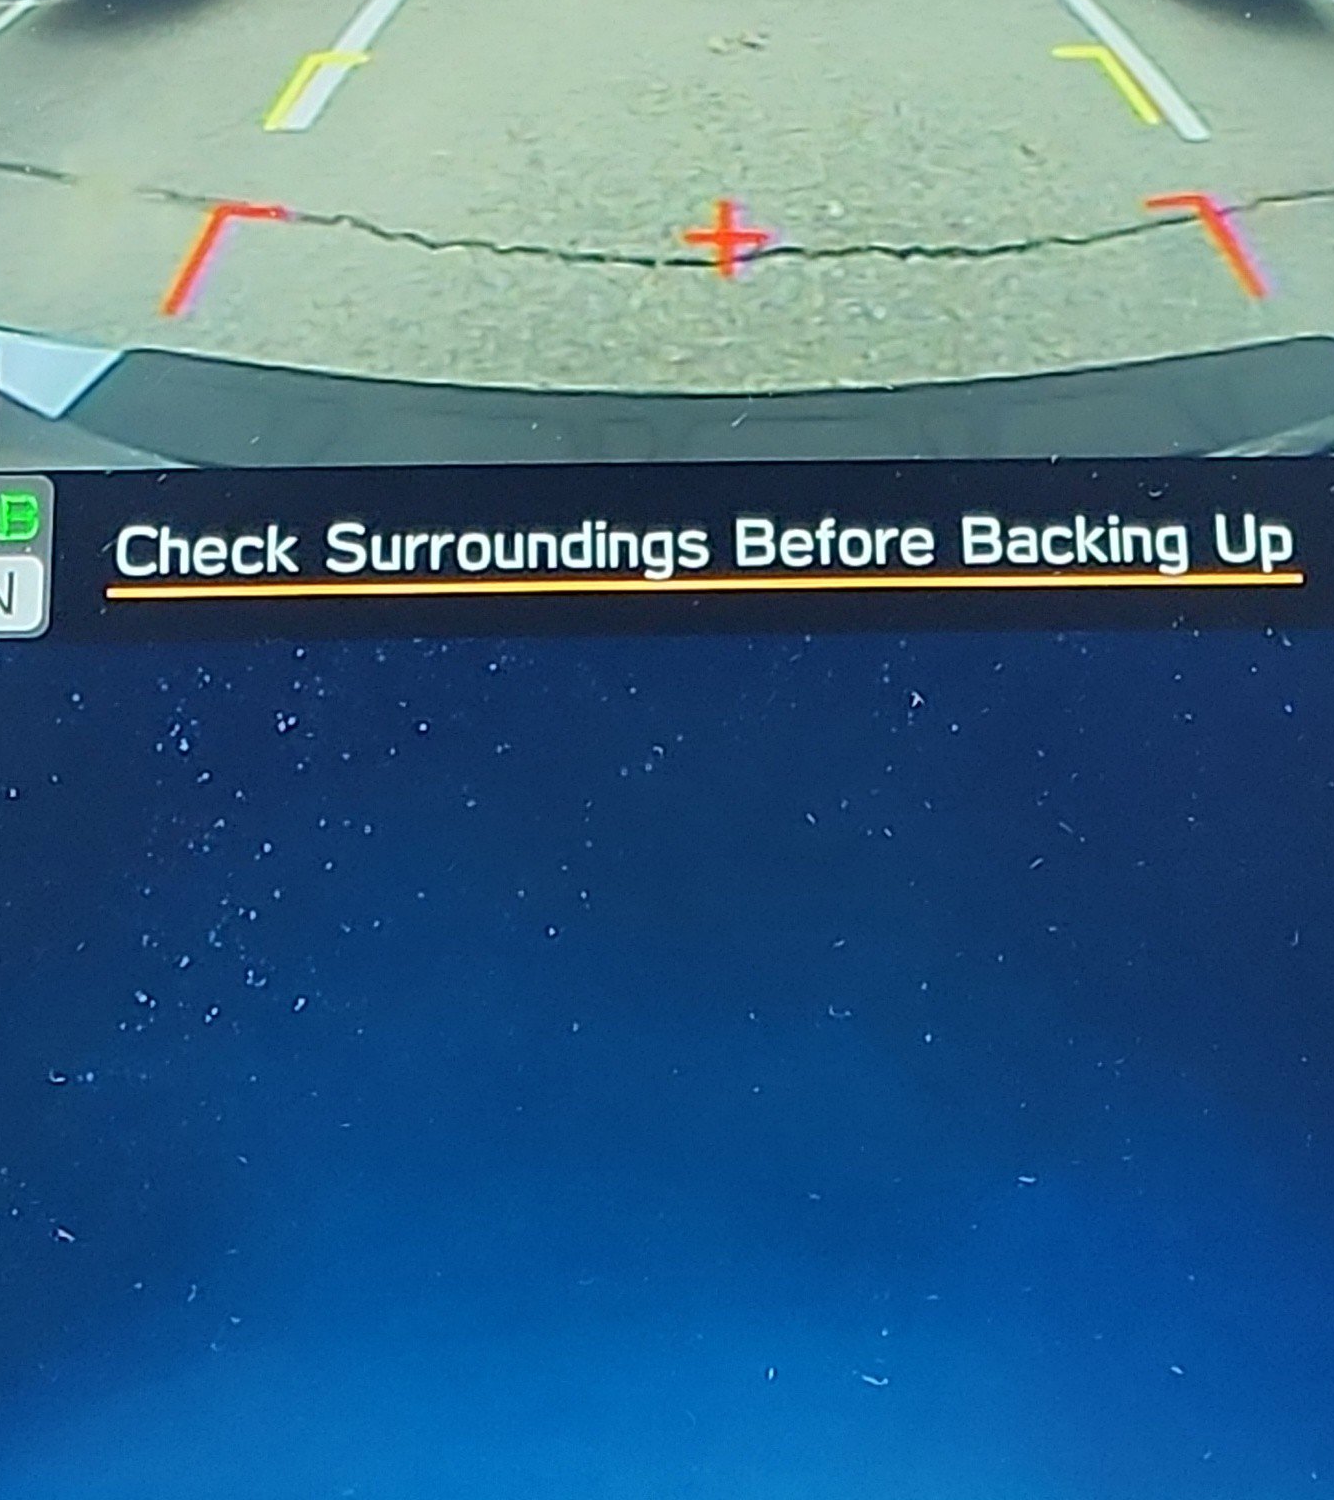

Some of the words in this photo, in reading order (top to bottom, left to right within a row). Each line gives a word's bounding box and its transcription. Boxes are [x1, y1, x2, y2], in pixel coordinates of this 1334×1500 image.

[115, 526, 298, 577] Check
[325, 521, 709, 580] Surroundings
[735, 516, 934, 567] Before
[962, 514, 1188, 573] Backing
[1215, 514, 1293, 572] Up
